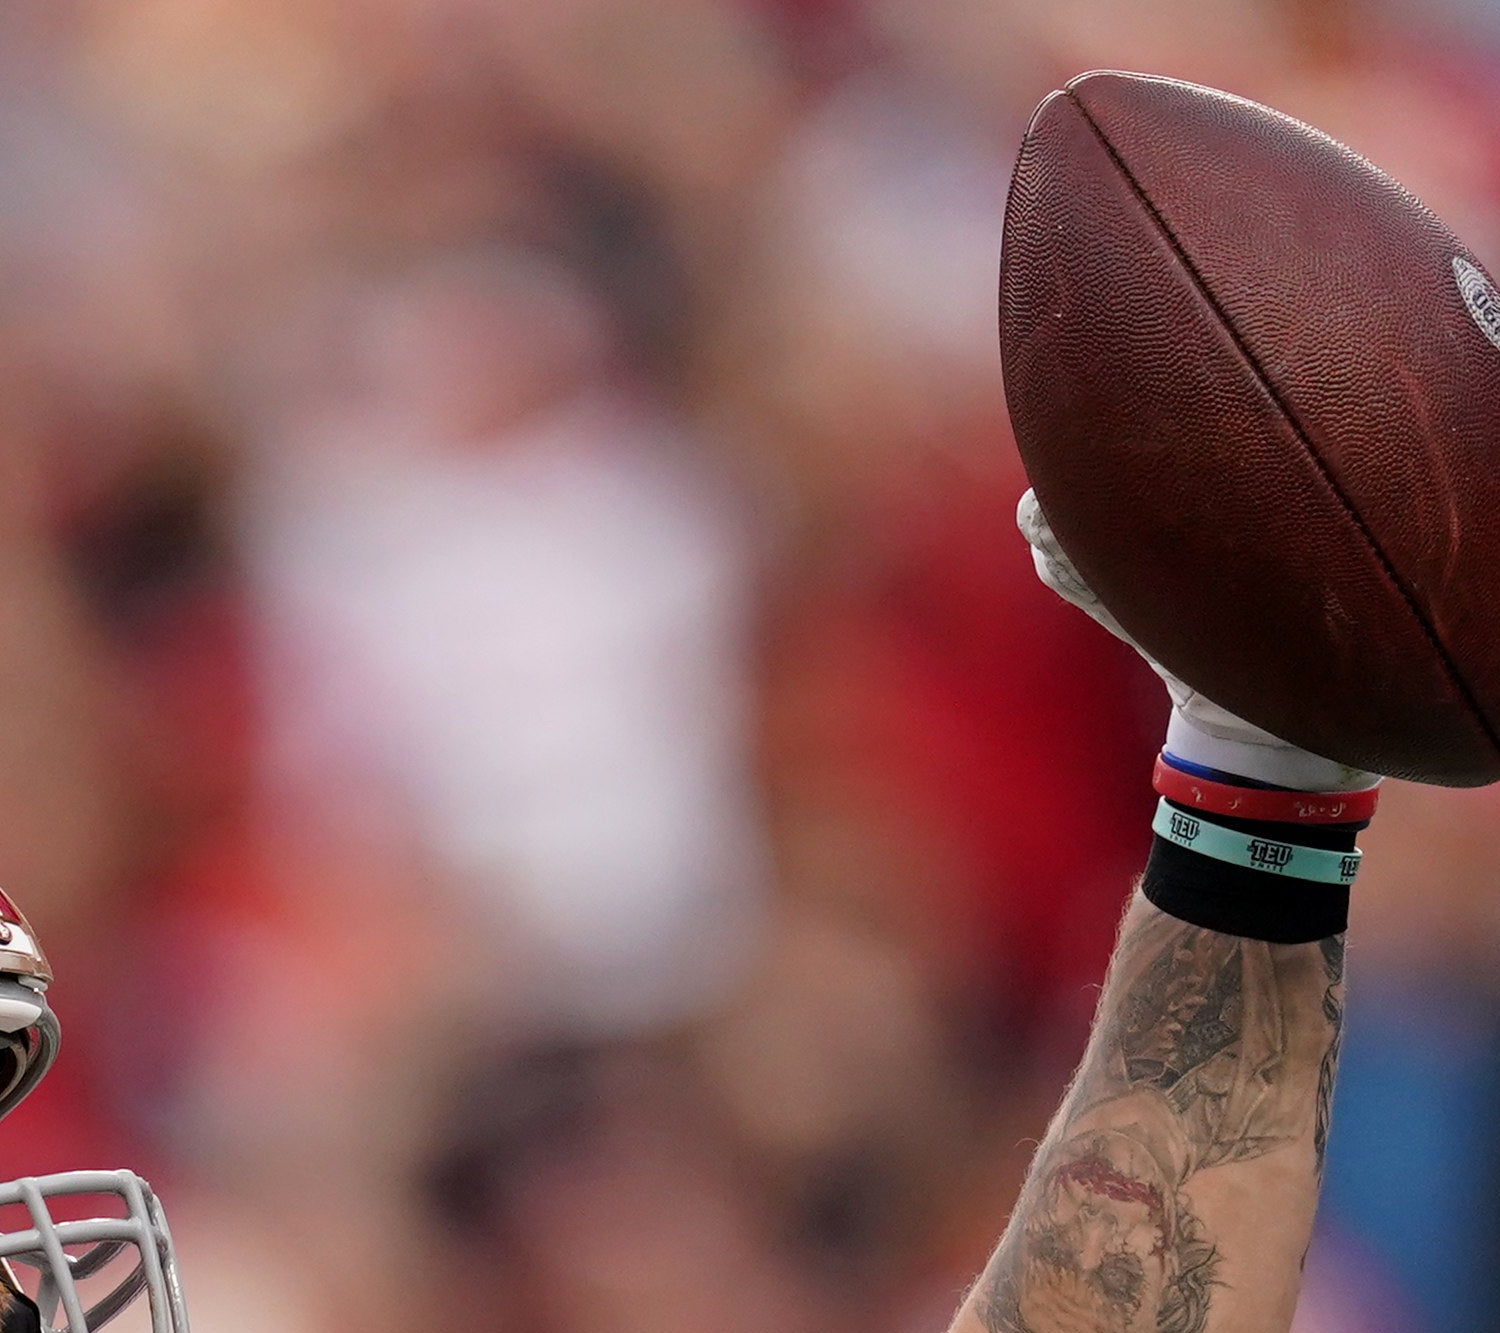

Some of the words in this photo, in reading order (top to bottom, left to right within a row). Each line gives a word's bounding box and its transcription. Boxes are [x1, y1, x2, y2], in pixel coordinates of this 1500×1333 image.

[1171, 812, 1200, 841] TEU
[1250, 839, 1292, 867] TEU
[1341, 855, 1361, 876] TE
